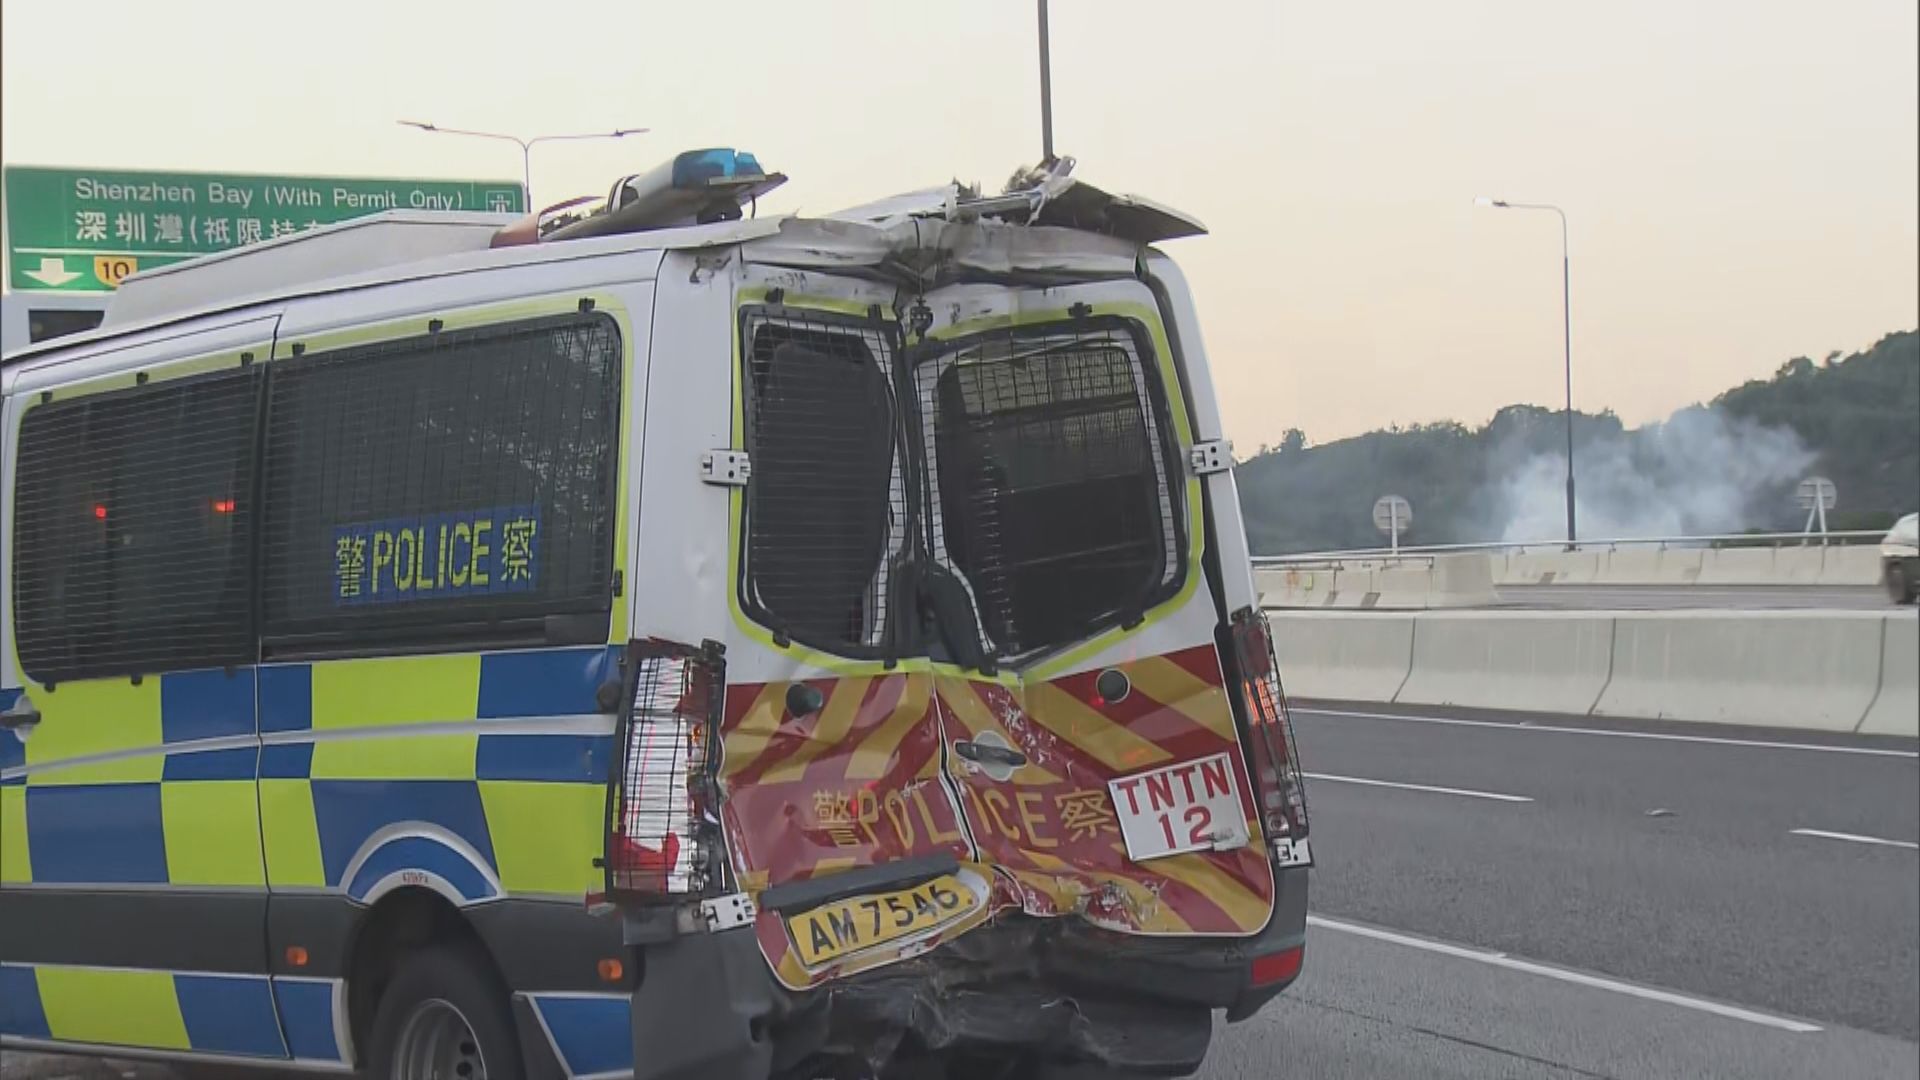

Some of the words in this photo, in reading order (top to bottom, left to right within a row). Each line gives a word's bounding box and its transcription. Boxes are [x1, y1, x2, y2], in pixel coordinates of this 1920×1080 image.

[75, 177, 196, 203] Shenzhen
[207, 182, 254, 209] Bay
[264, 185, 322, 207] (With
[333, 187, 397, 209] Permit
[409, 189, 463, 211] Only)
[102, 261, 130, 280] 10
[371, 519, 493, 594] POLICE
[1117, 758, 1231, 816] TNTN
[857, 783, 1058, 849] POLICE
[1158, 805, 1212, 849] 12
[808, 906, 859, 956] AM
